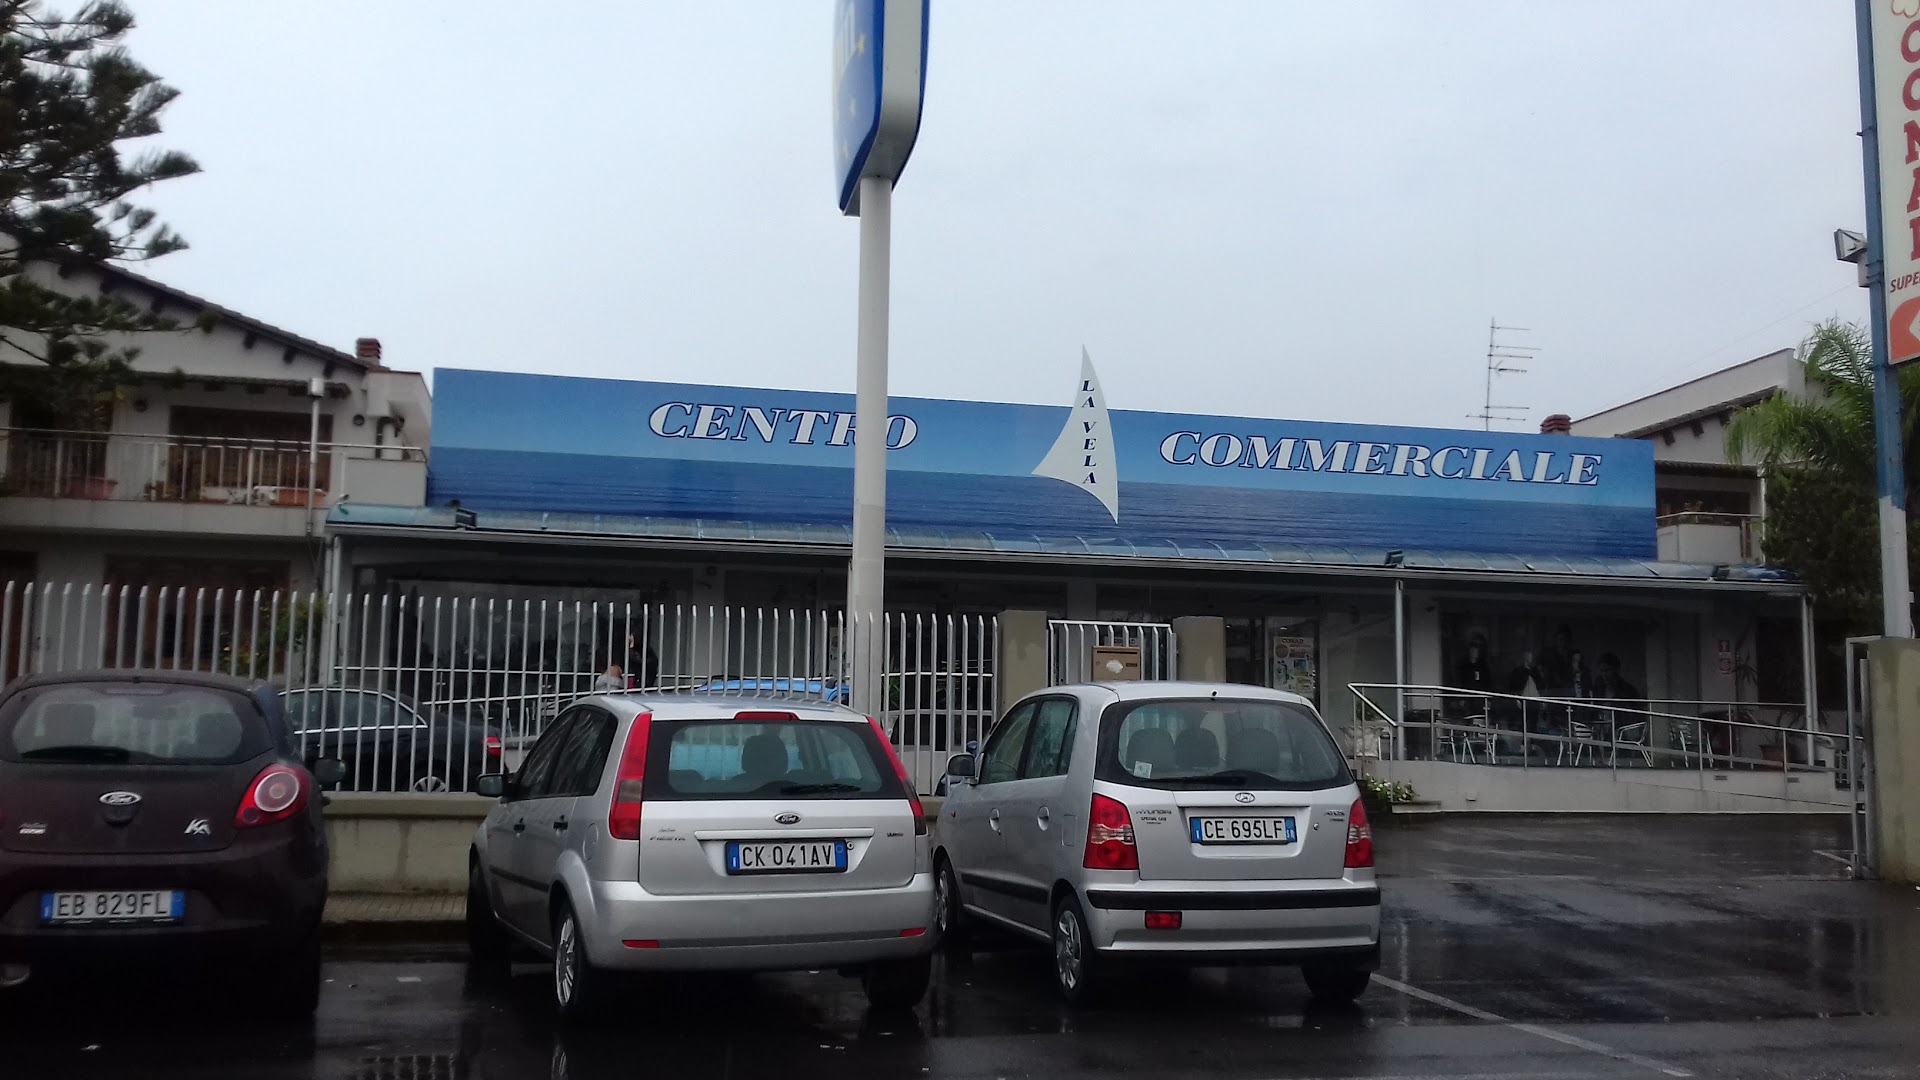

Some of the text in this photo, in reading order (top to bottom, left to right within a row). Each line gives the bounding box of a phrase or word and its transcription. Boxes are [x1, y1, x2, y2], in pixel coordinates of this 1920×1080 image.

[649, 401, 918, 450] CENTRO
[1081, 379, 1098, 484] LA VELA
[1159, 430, 1602, 486] COMMERCIALE
[1204, 820, 1225, 839] CE
[1231, 820, 1283, 839] 695LF
[742, 846, 766, 867] CK
[772, 844, 832, 866] 041AV
[57, 893, 86, 916] EB
[95, 892, 168, 916] 829FL
